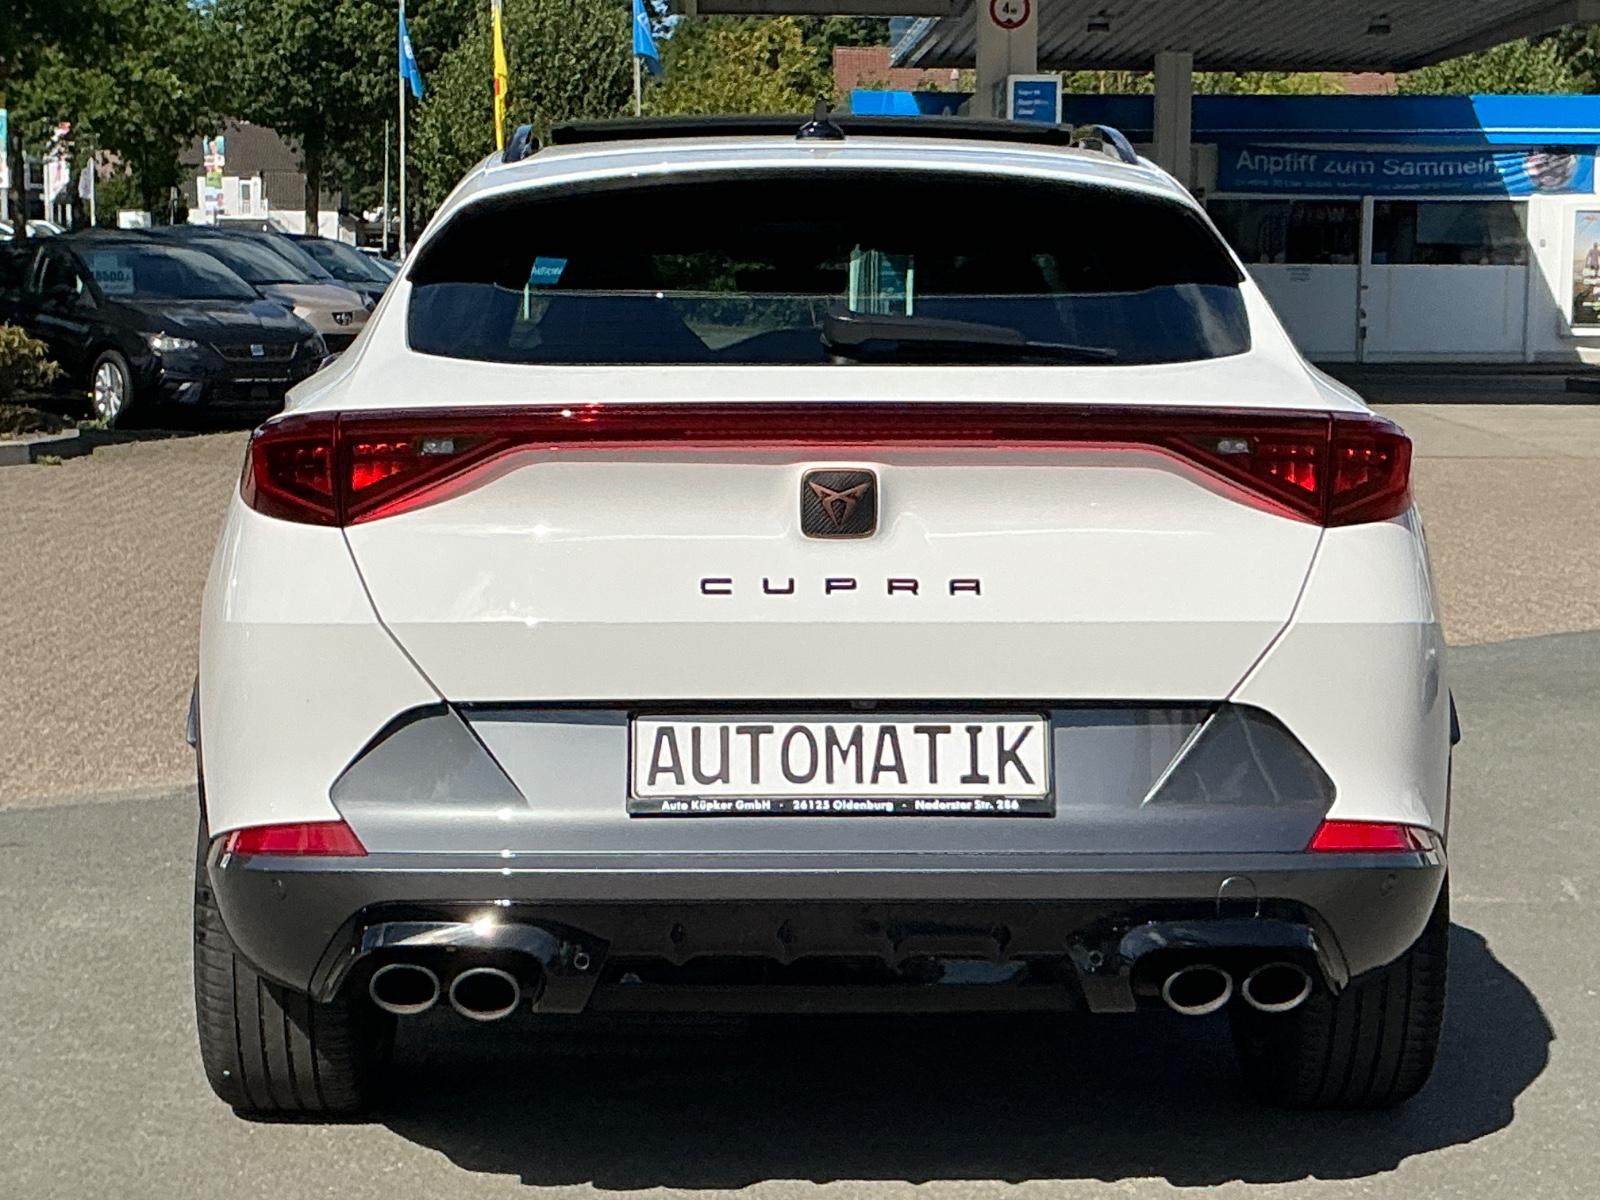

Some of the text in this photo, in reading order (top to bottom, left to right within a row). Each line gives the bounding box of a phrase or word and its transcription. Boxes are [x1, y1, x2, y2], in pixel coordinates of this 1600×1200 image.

[1236, 150, 1318, 175] Anpfiff
[1323, 160, 1376, 175] zum
[700, 577, 981, 596] CUPRA
[647, 725, 1036, 786] AUTOMATIK
[661, 800, 689, 811] Auto
[691, 799, 733, 812] Küpker
[735, 800, 771, 811] GmbH
[793, 800, 830, 811] 26125
[832, 800, 895, 812] Oldenburg
[974, 800, 994, 811] Str.
